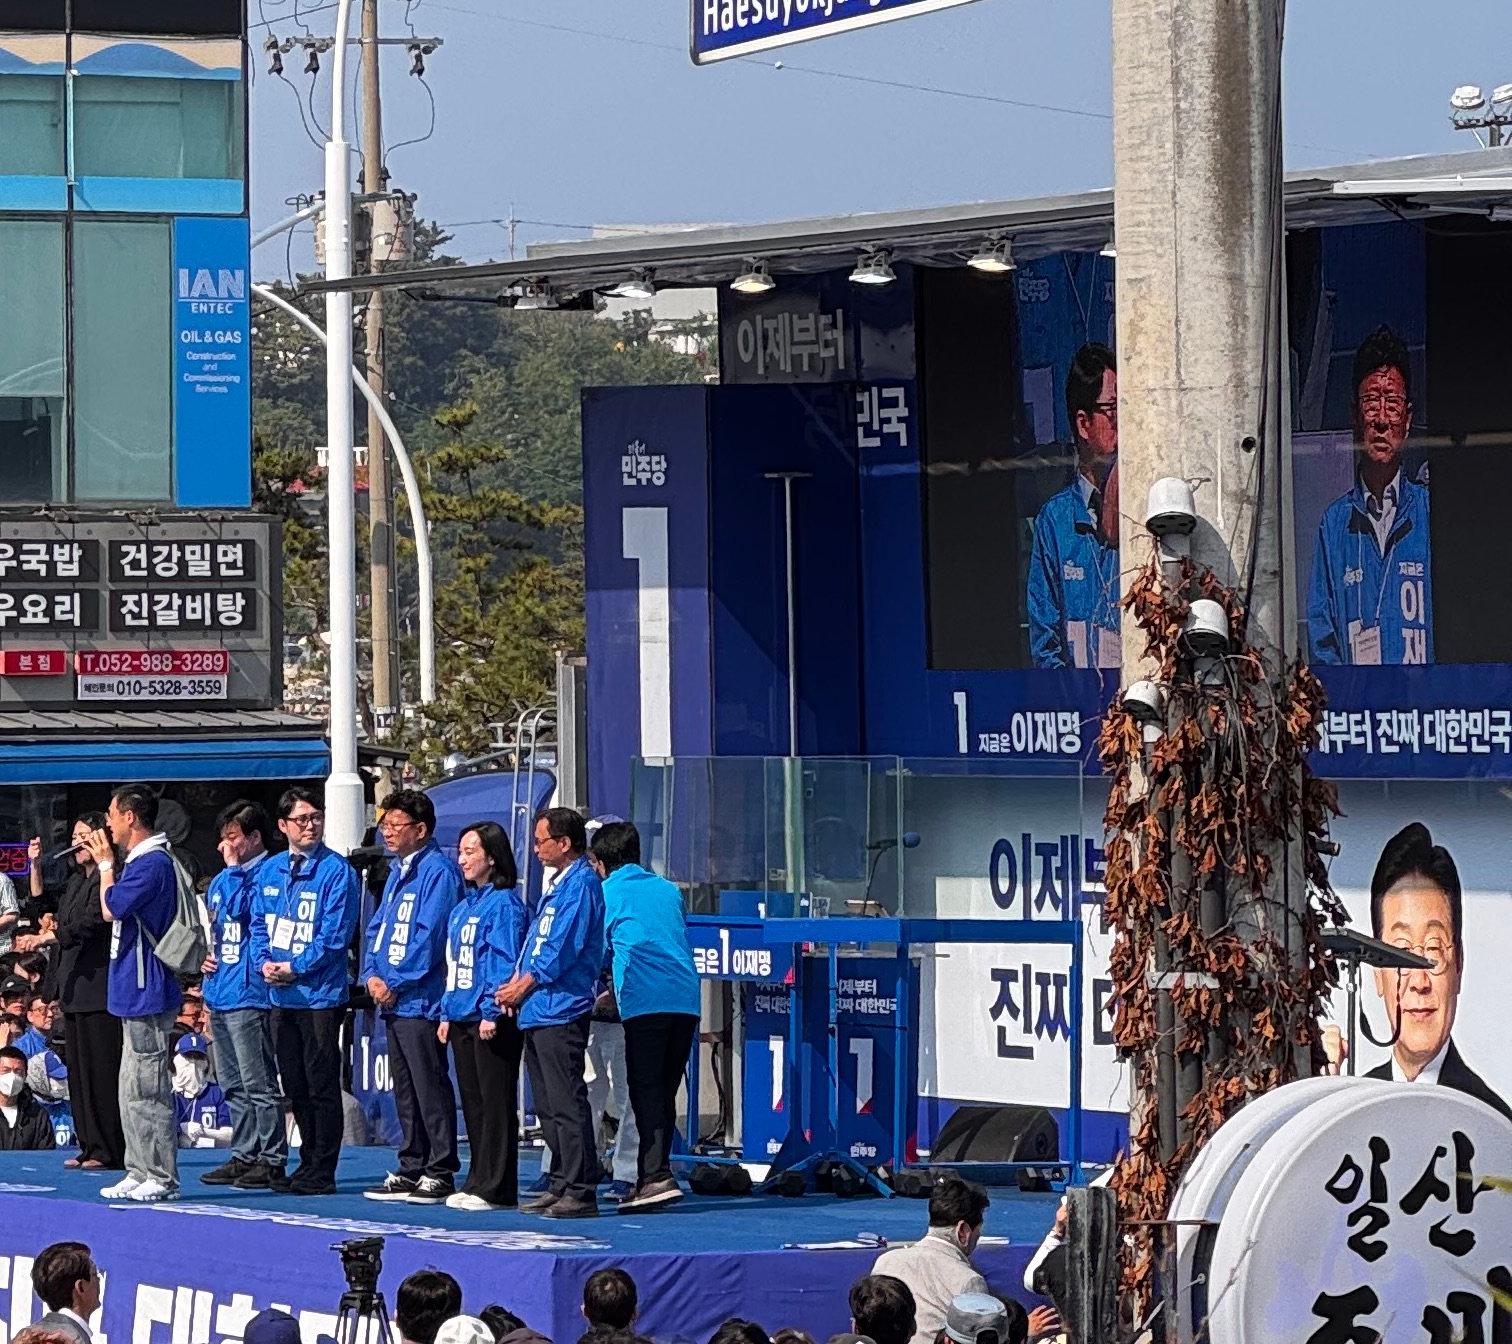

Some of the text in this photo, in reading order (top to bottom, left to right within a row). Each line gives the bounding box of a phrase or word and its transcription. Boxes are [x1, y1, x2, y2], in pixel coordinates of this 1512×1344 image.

[179, 268, 245, 298] IAN
[191, 303, 234, 314] ENTEC
[181, 331, 202, 344] OIL
[214, 331, 242, 344] GAS
[737, 308, 846, 375] 이제부터
[621, 454, 667, 486] 민주당
[119, 543, 245, 578] 건강밀면
[120, 592, 246, 627] 진갈비탕
[622, 507, 671, 761] 1
[84, 654, 225, 673] T.052-988-3289
[116, 677, 223, 696] 010-5328-3559
[953, 691, 1082, 754] 1 지금은 이재명
[1375, 709, 1420, 754] 진짜
[1423, 709, 1512, 754] 대한민국
[221, 914, 241, 964] 재명
[719, 928, 729, 975] 1
[732, 949, 771, 976] 이재명
[849, 1038, 874, 1114] 1
[1325, 1131, 1496, 1263] 일산
